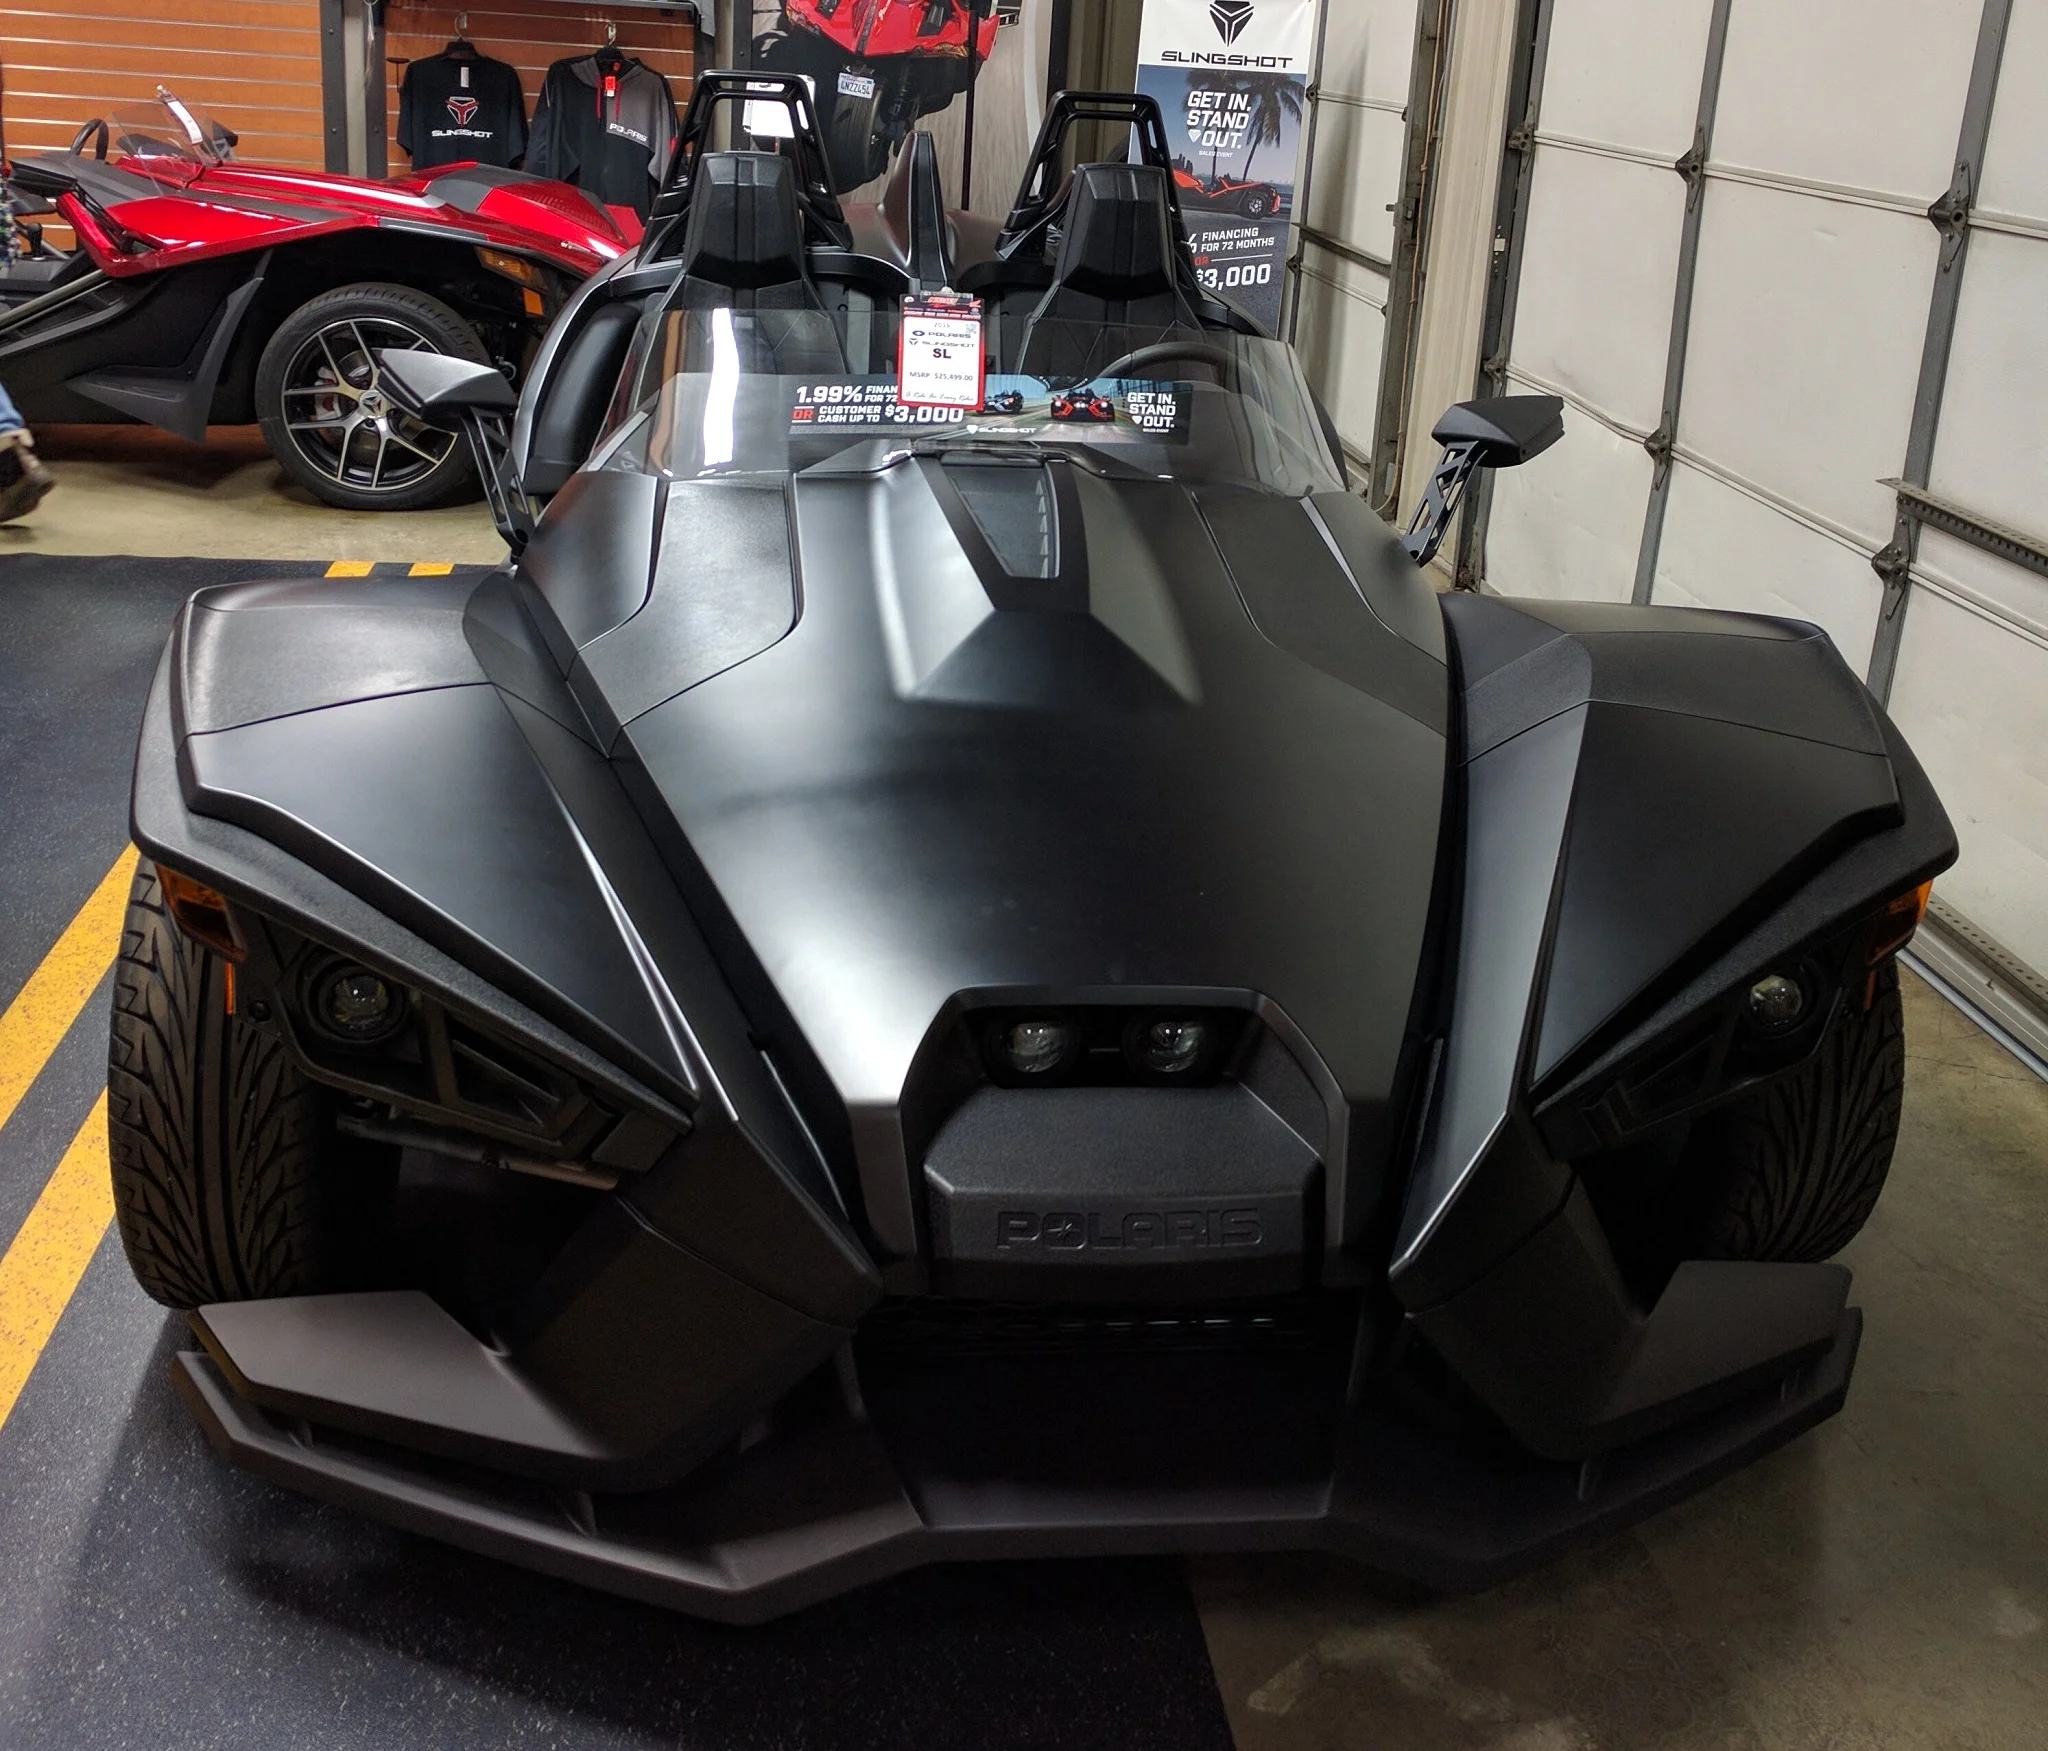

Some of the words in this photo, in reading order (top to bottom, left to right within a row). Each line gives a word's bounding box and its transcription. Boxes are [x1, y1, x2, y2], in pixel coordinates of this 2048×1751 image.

[1161, 50, 1293, 69] SLINGSHOT
[1187, 90, 1226, 109] GET
[1227, 93, 1252, 111] IN.
[1186, 110, 1250, 129] STAND
[431, 129, 493, 138] SLINGSHOT
[609, 122, 648, 142] POLARIS
[1201, 131, 1243, 149] OUT.
[1202, 227, 1259, 242] FINANCING
[1201, 243, 1219, 253] FOR
[1221, 241, 1234, 251] 72
[1236, 237, 1275, 250] MONTHS
[1194, 256, 1210, 266] OR
[1196, 263, 1271, 290] $3,000
[928, 331, 972, 339] POLARIS
[922, 340, 975, 348] SLINGSHOT
[932, 348, 952, 359] SL
[934, 372, 974, 381] $25,499.00
[796, 385, 863, 403] 1.99%
[864, 394, 885, 403] FOR
[885, 394, 898, 403] 72
[1127, 392, 1156, 403] GET
[1157, 393, 1176, 405] IN.
[792, 408, 815, 420] OR
[818, 405, 881, 414] CUSTOMER
[884, 403, 964, 423] $3,000
[1129, 403, 1176, 416] STAND
[817, 414, 848, 423] CASH
[848, 414, 865, 423] UP
[866, 414, 880, 423] TO
[1143, 415, 1175, 428] OUT.
[997, 1208, 1262, 1250] POLARIS
